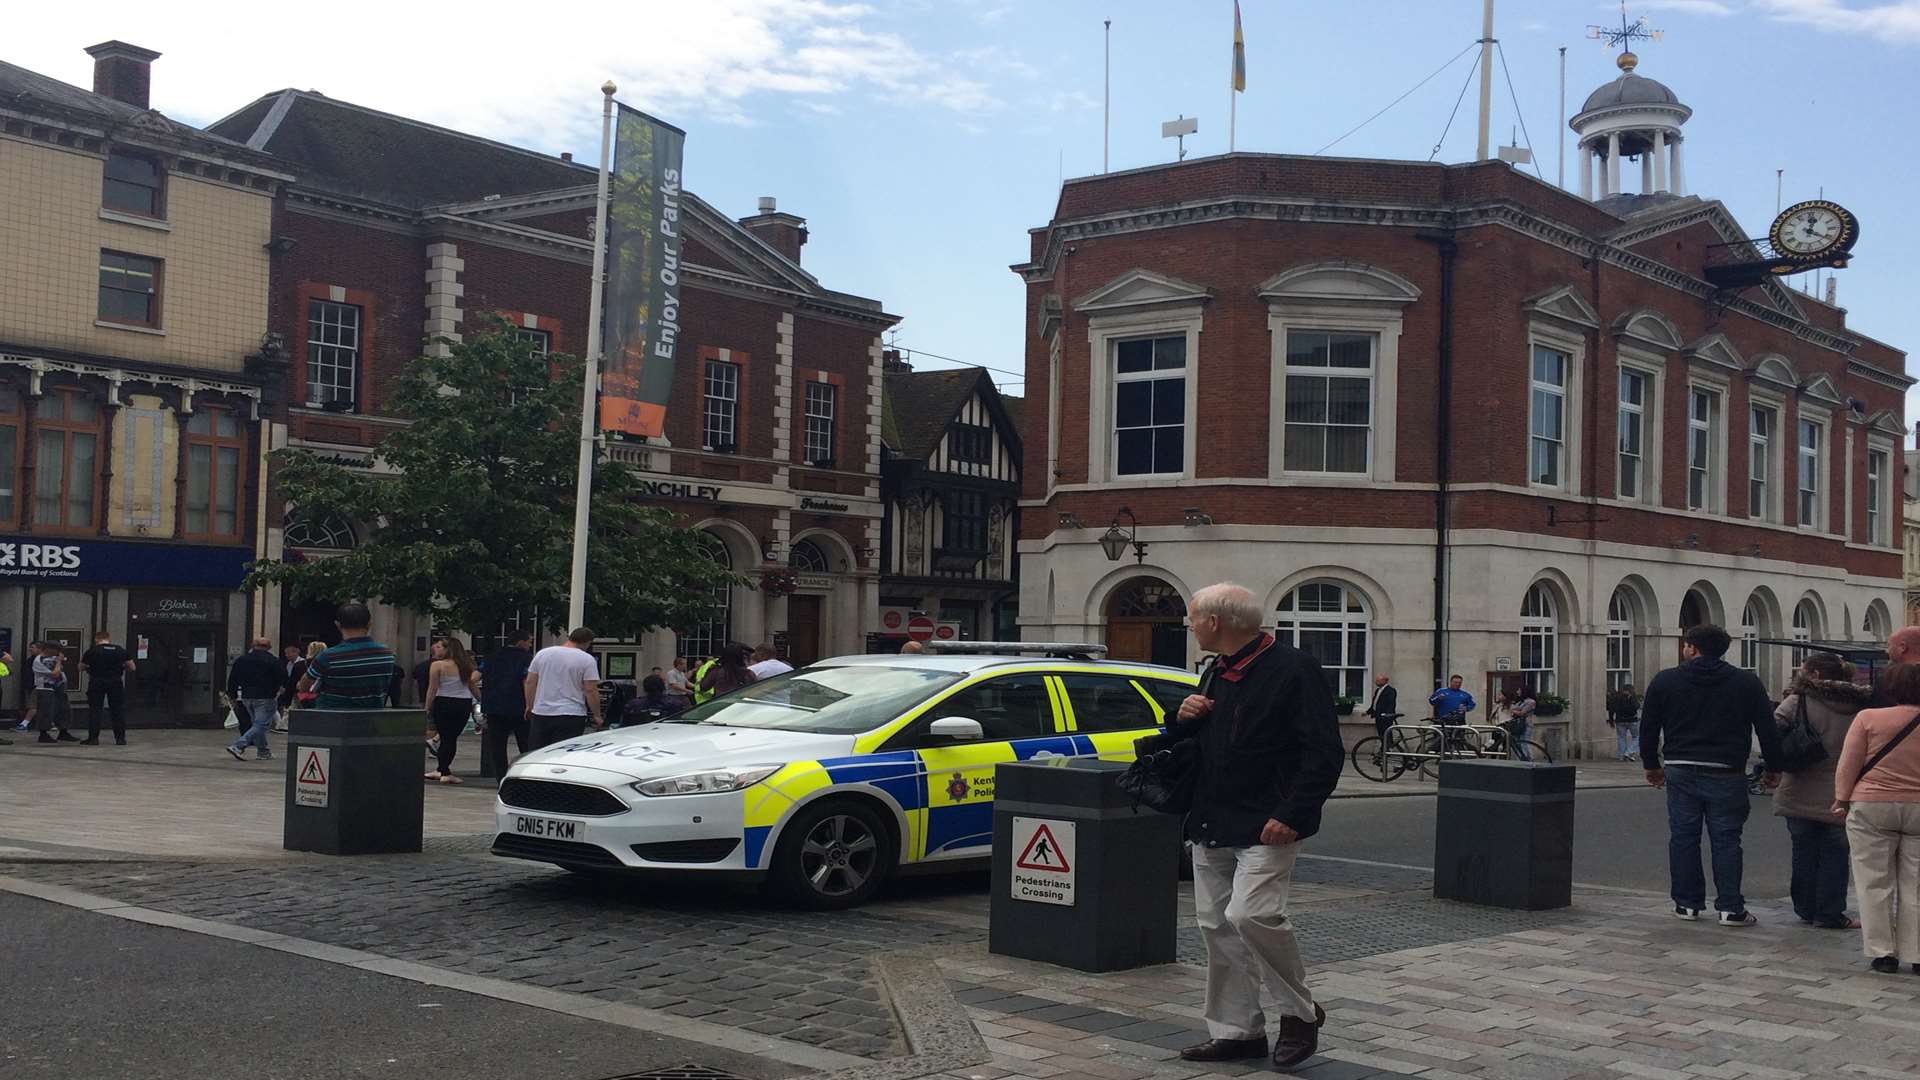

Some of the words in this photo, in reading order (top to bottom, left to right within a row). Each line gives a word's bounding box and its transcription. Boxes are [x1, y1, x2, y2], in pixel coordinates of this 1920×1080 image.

[660, 168, 680, 238] Parks
[660, 243, 679, 287] Our
[655, 291, 680, 359] Enjoy
[20, 544, 80, 569] RBS
[49, 569, 79, 577] Scotland
[545, 742, 676, 763] POLICE
[974, 776, 995, 786] Kent
[974, 787, 995, 798] Polic
[516, 816, 544, 836] GN15
[546, 820, 575, 839] FKM
[1015, 875, 1071, 890] Pedestrians
[1022, 886, 1064, 901] Crossing
